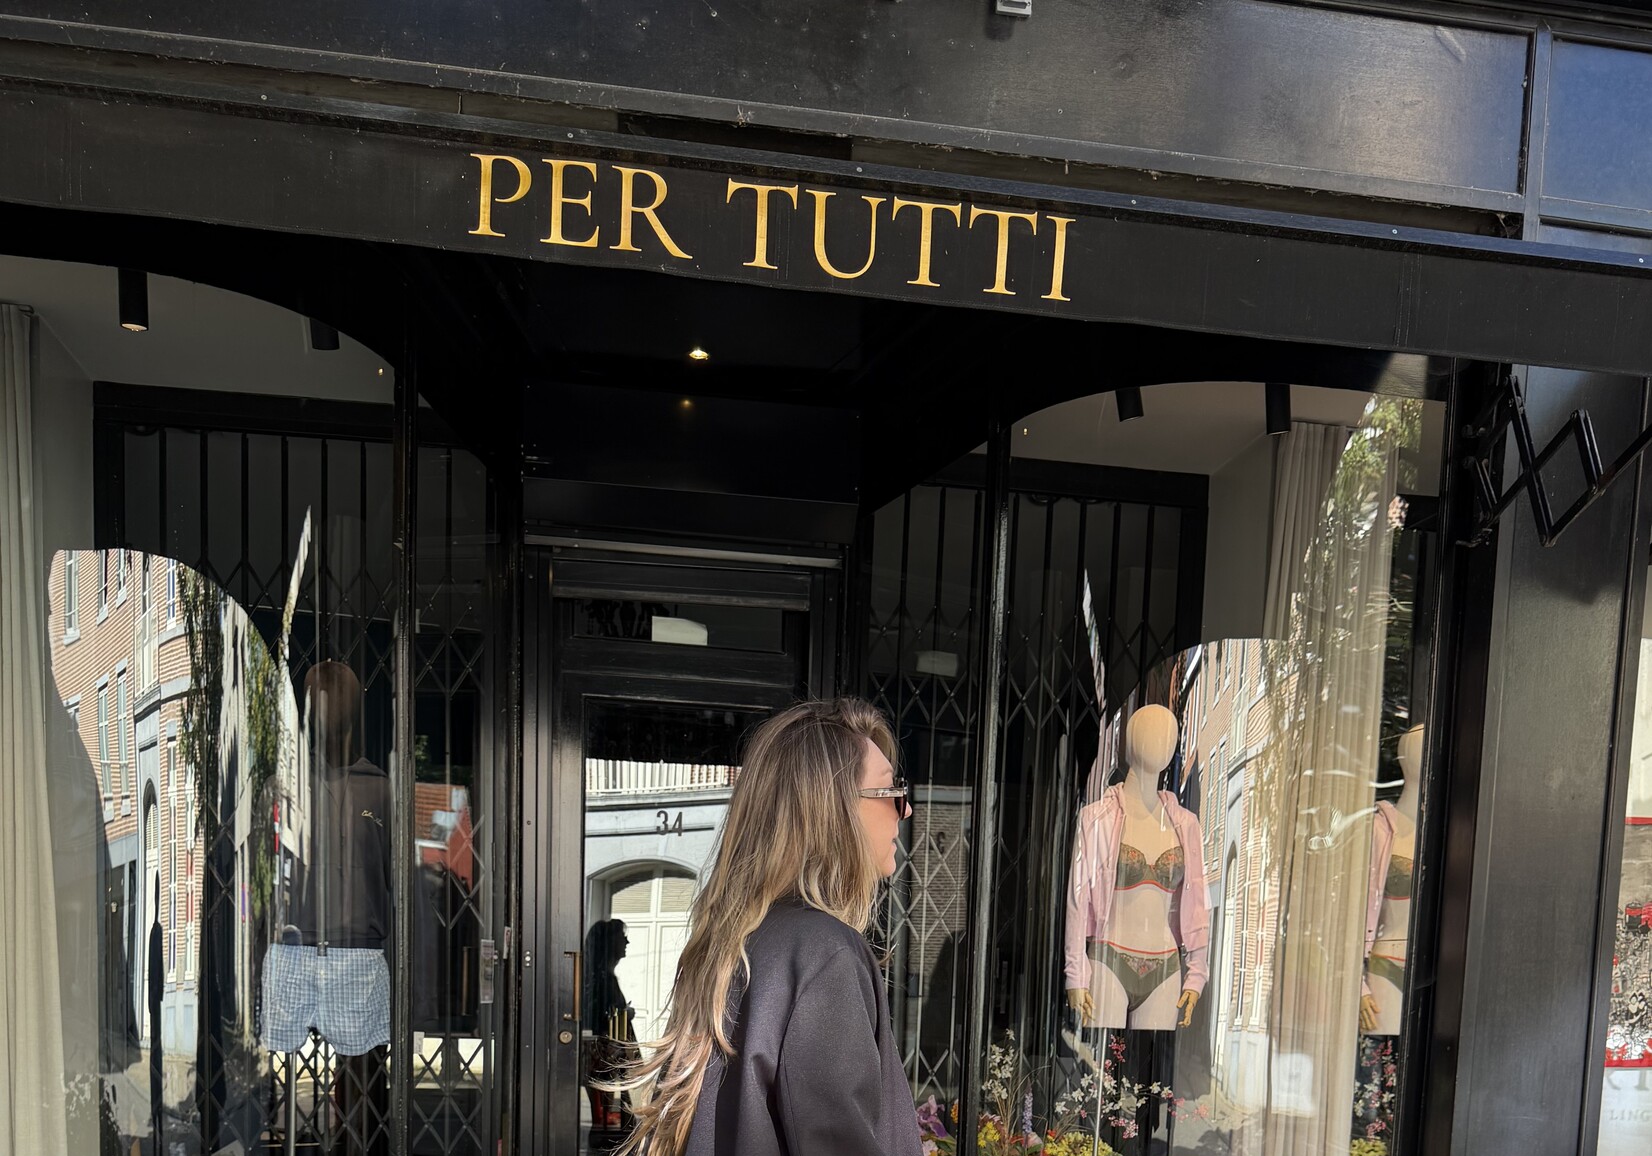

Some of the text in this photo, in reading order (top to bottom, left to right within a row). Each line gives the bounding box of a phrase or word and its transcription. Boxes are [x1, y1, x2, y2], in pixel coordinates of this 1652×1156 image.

[468, 152, 1077, 302] PER TUTTI
[656, 809, 683, 837] 34
